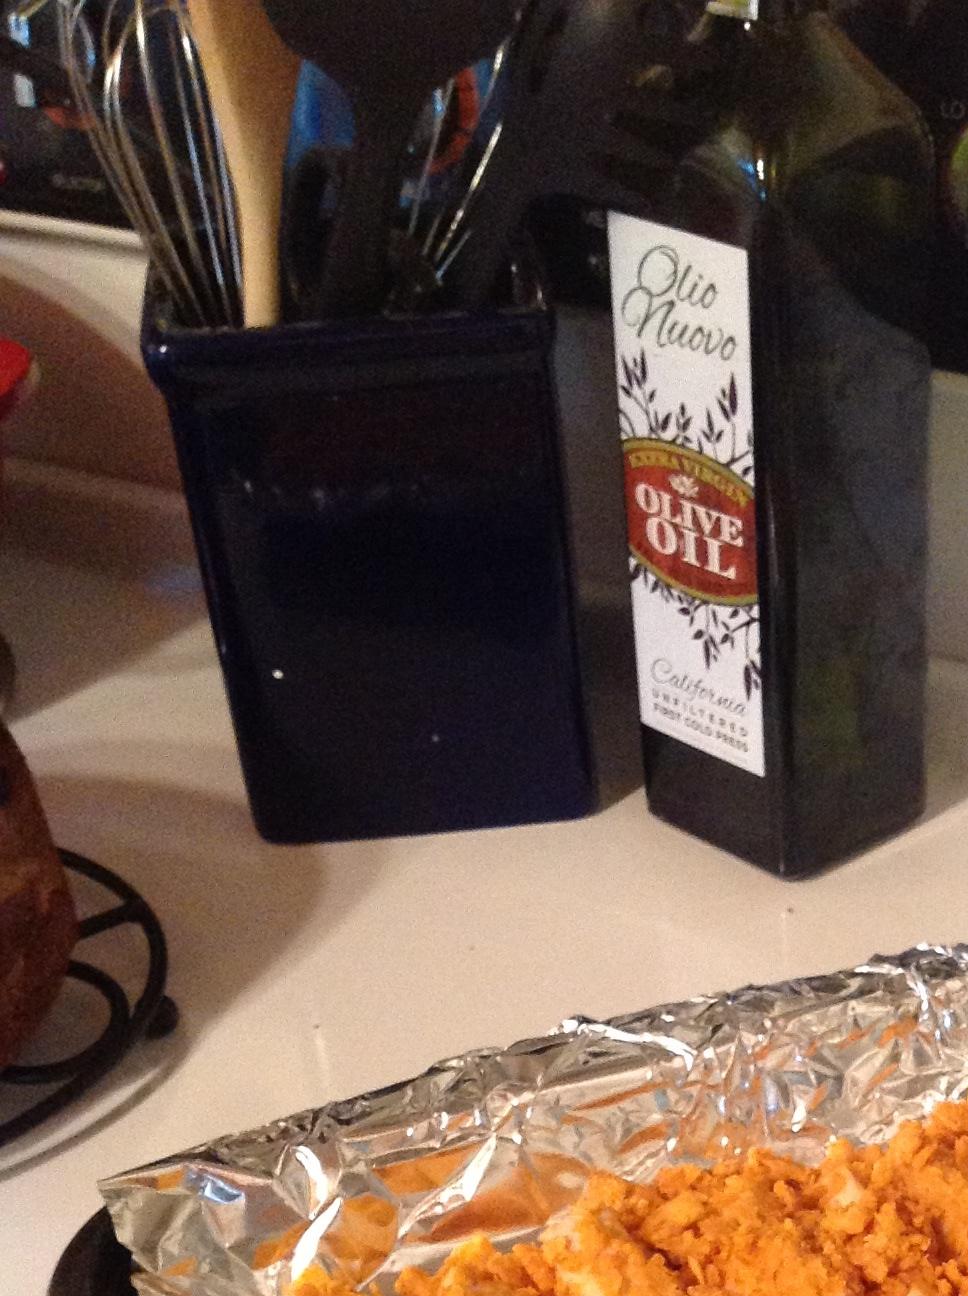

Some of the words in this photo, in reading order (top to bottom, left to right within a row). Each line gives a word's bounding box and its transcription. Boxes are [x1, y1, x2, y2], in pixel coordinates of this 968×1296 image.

[637, 244, 718, 309] Olio
[621, 286, 738, 361] Nuovo
[634, 483, 744, 548] OLIVE
[645, 516, 737, 580] OIL
